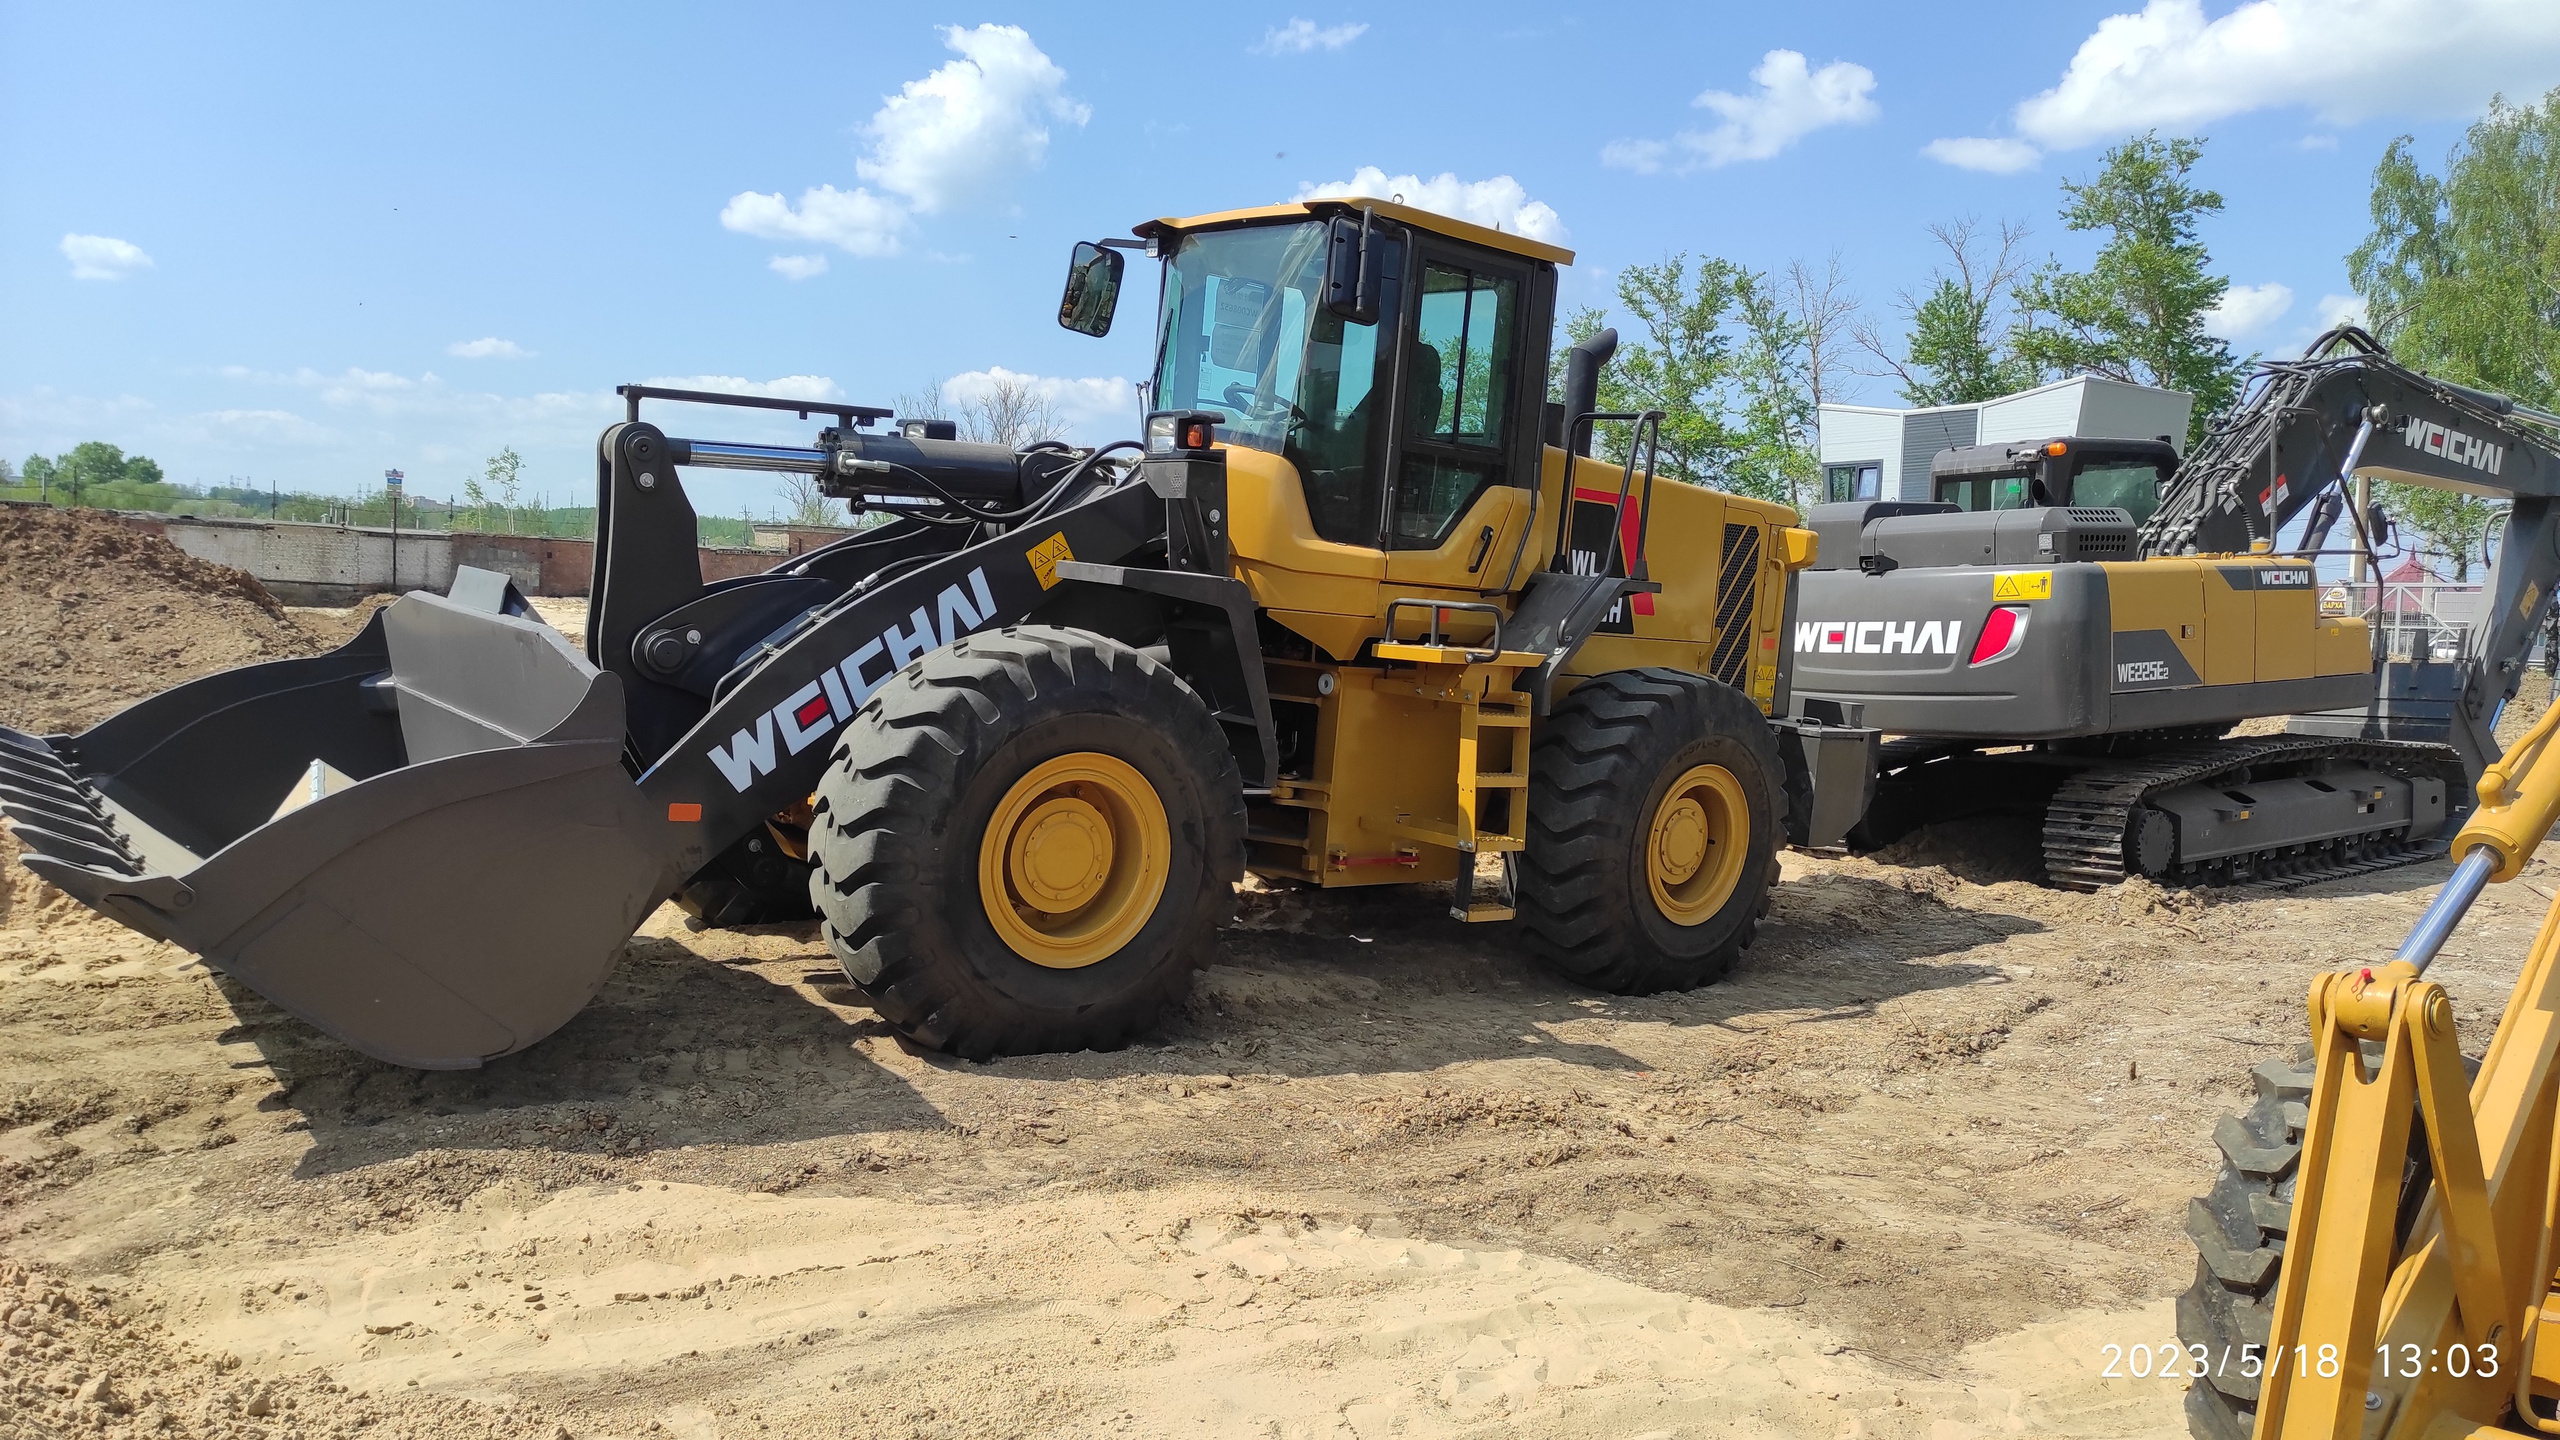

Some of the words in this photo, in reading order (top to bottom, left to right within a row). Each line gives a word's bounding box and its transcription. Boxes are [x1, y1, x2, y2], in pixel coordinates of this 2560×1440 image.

[2405, 415, 2504, 476] WEICHAI
[1572, 549, 1601, 577] WL
[2260, 570, 2309, 585] WEICHAI
[1794, 620, 1962, 654] WEICHAI
[706, 565, 998, 794] WEICHAI
[2117, 660, 2169, 683] WE225E2
